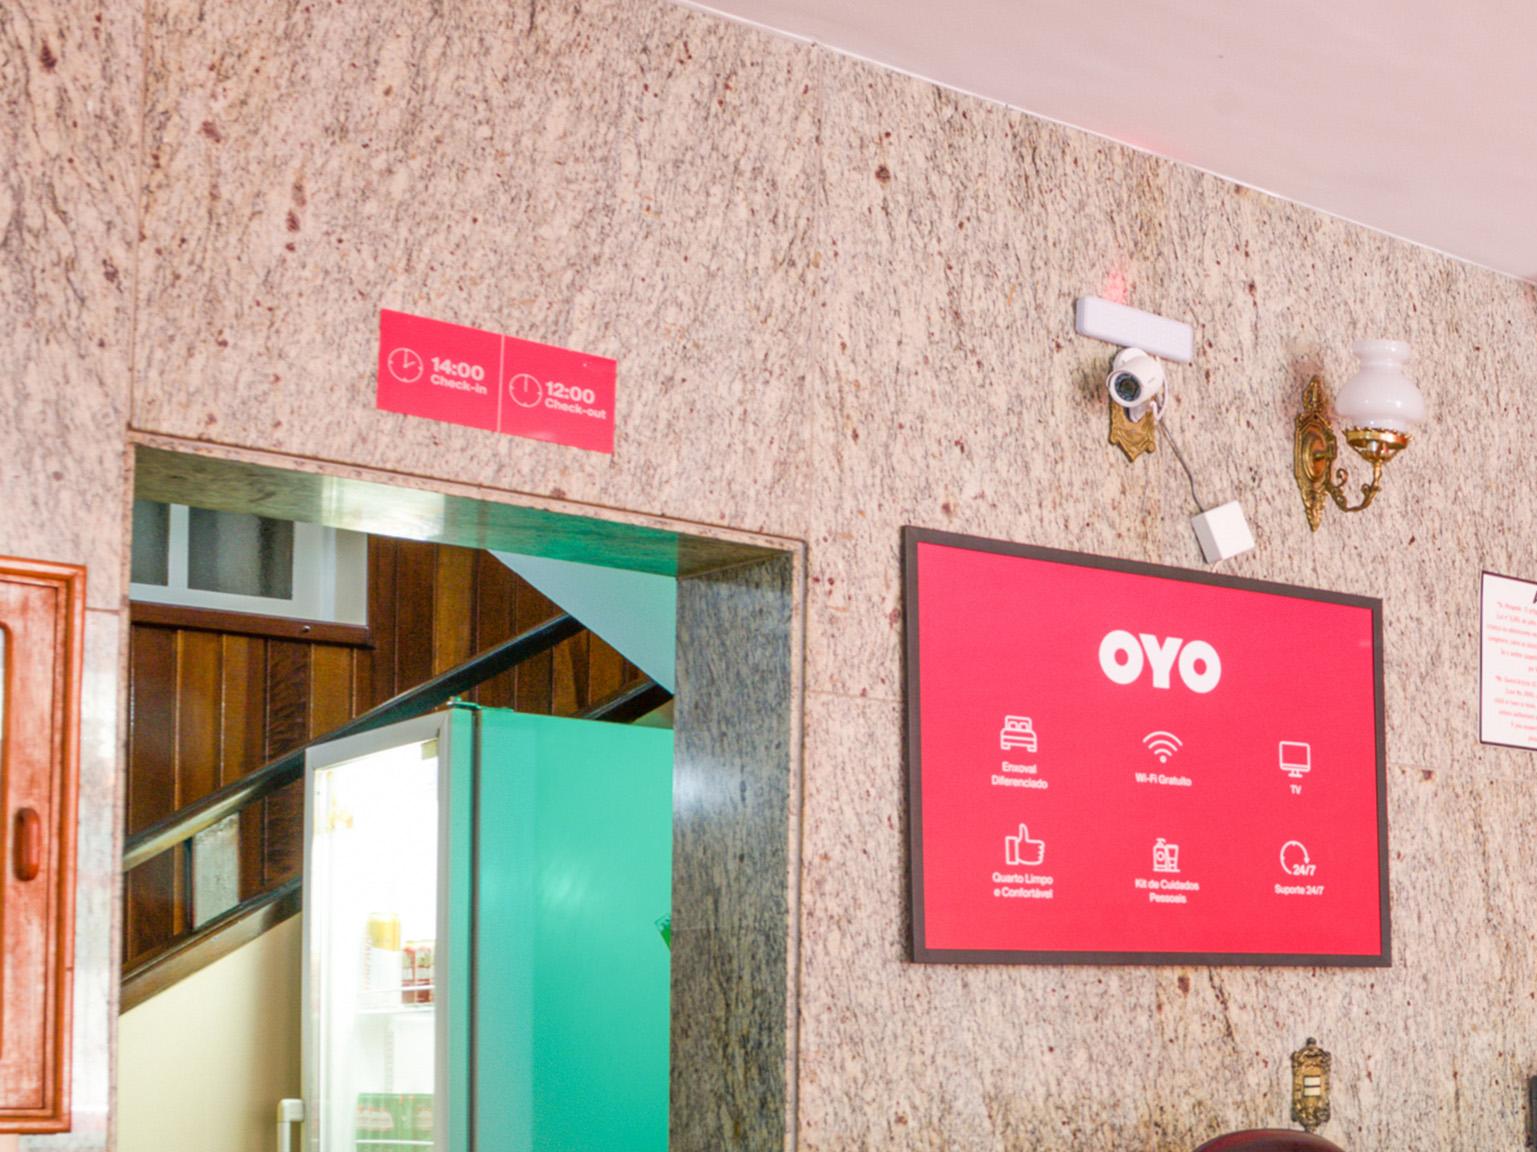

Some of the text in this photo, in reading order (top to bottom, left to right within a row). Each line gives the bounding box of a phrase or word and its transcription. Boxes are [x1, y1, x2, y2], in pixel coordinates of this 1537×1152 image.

[430, 357, 485, 381] 14:00
[429, 374, 488, 396] Check-in
[545, 381, 596, 405] 12:00
[544, 398, 608, 421] Check-out
[1098, 629, 1222, 694] OYO
[991, 774, 1049, 790] Diferenciado
[1158, 774, 1193, 787] Gratuito
[1289, 784, 1303, 795] TV
[992, 871, 1024, 884] Quarto
[1292, 863, 1317, 877] 24/7
[1274, 883, 1325, 896] Suporte 24/7
